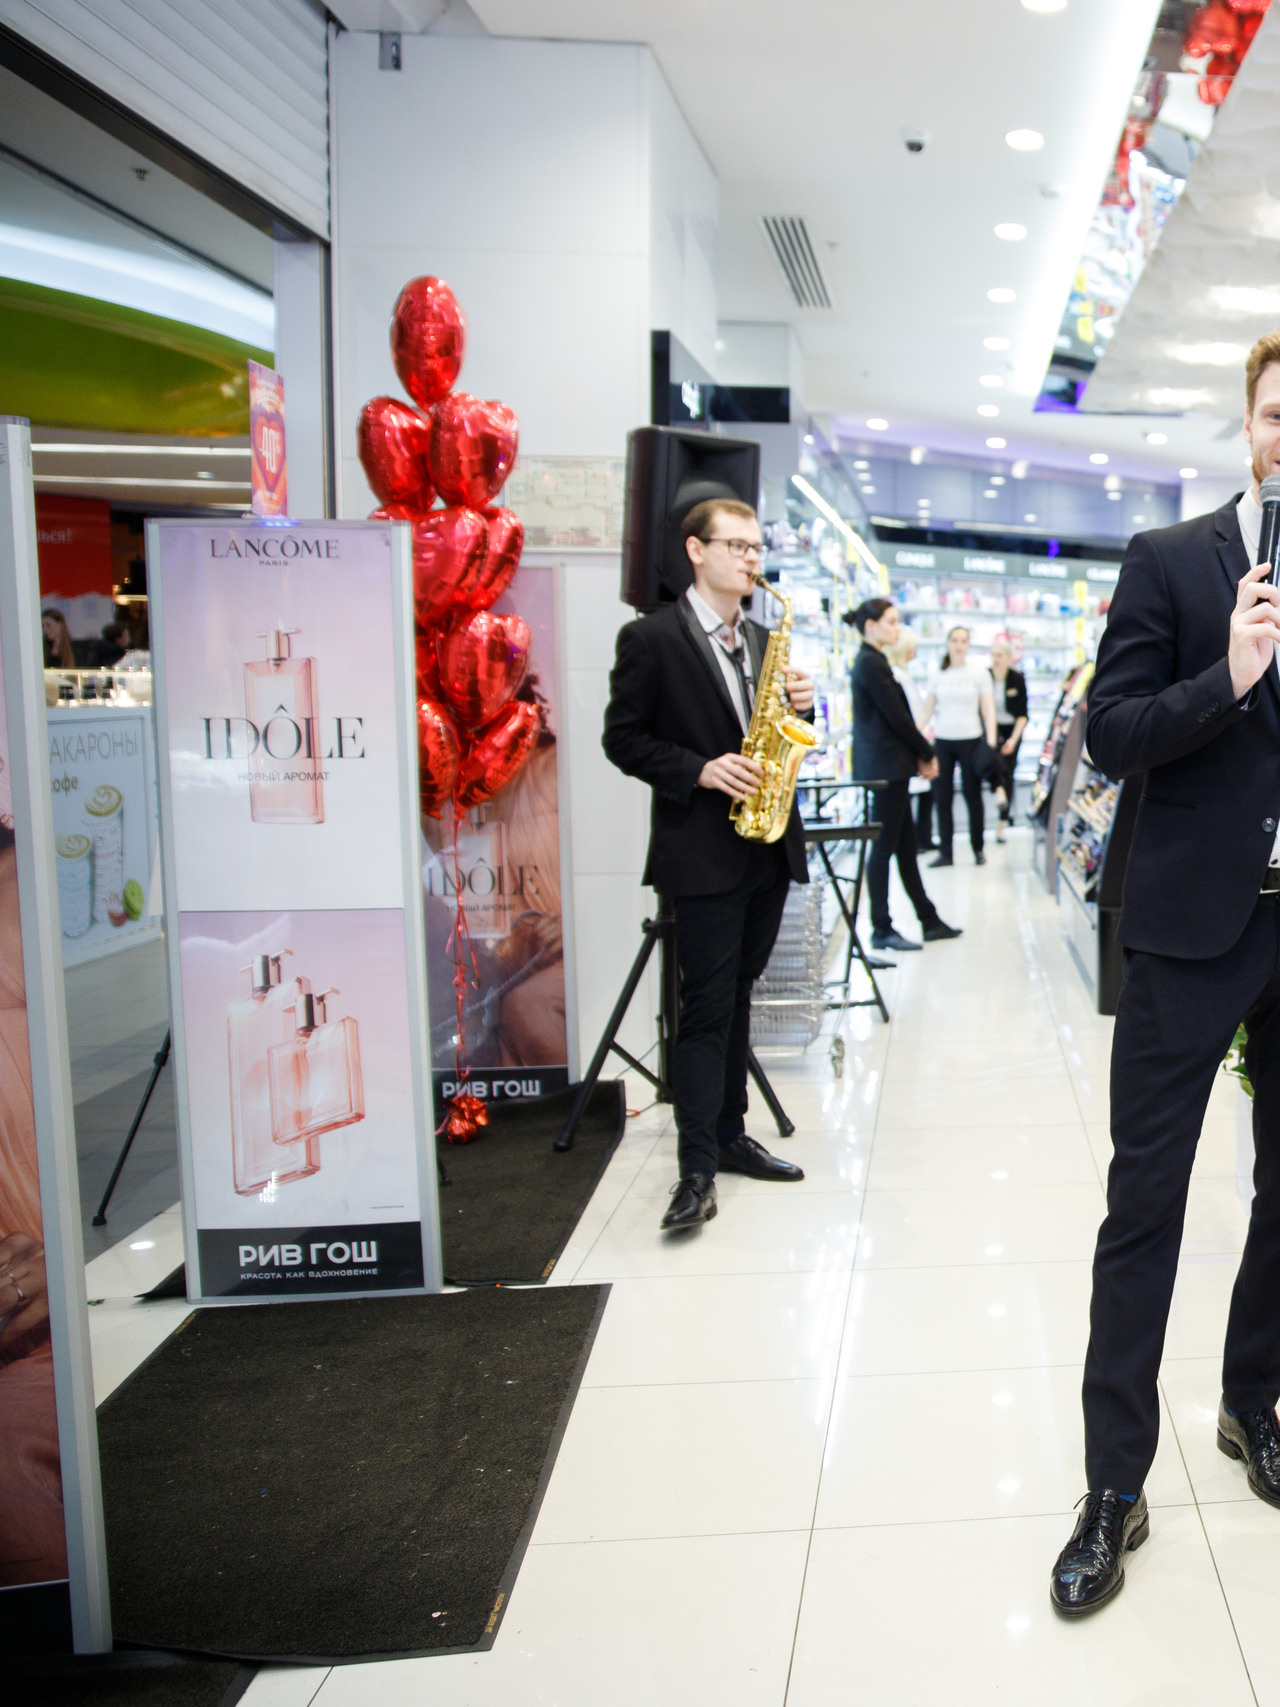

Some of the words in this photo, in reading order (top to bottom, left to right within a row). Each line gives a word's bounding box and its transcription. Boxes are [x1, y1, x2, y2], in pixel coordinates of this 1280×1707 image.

[209, 535, 339, 559] LANCÔME
[198, 703, 366, 760] IDÔLE
[237, 772, 281, 782] НОВЫЙ
[282, 771, 330, 782] АРОМАТ
[427, 857, 540, 896] IDÔLE
[442, 1081, 488, 1098] РИВ
[492, 1080, 541, 1097] ГОШ
[238, 1243, 303, 1268] РИВ
[309, 1240, 378, 1265] ГОШ
[240, 1272, 283, 1281] КРАСОТА
[286, 1271, 305, 1279] КАК
[308, 1267, 378, 1279] ВДОХНОВЕНИЕ
